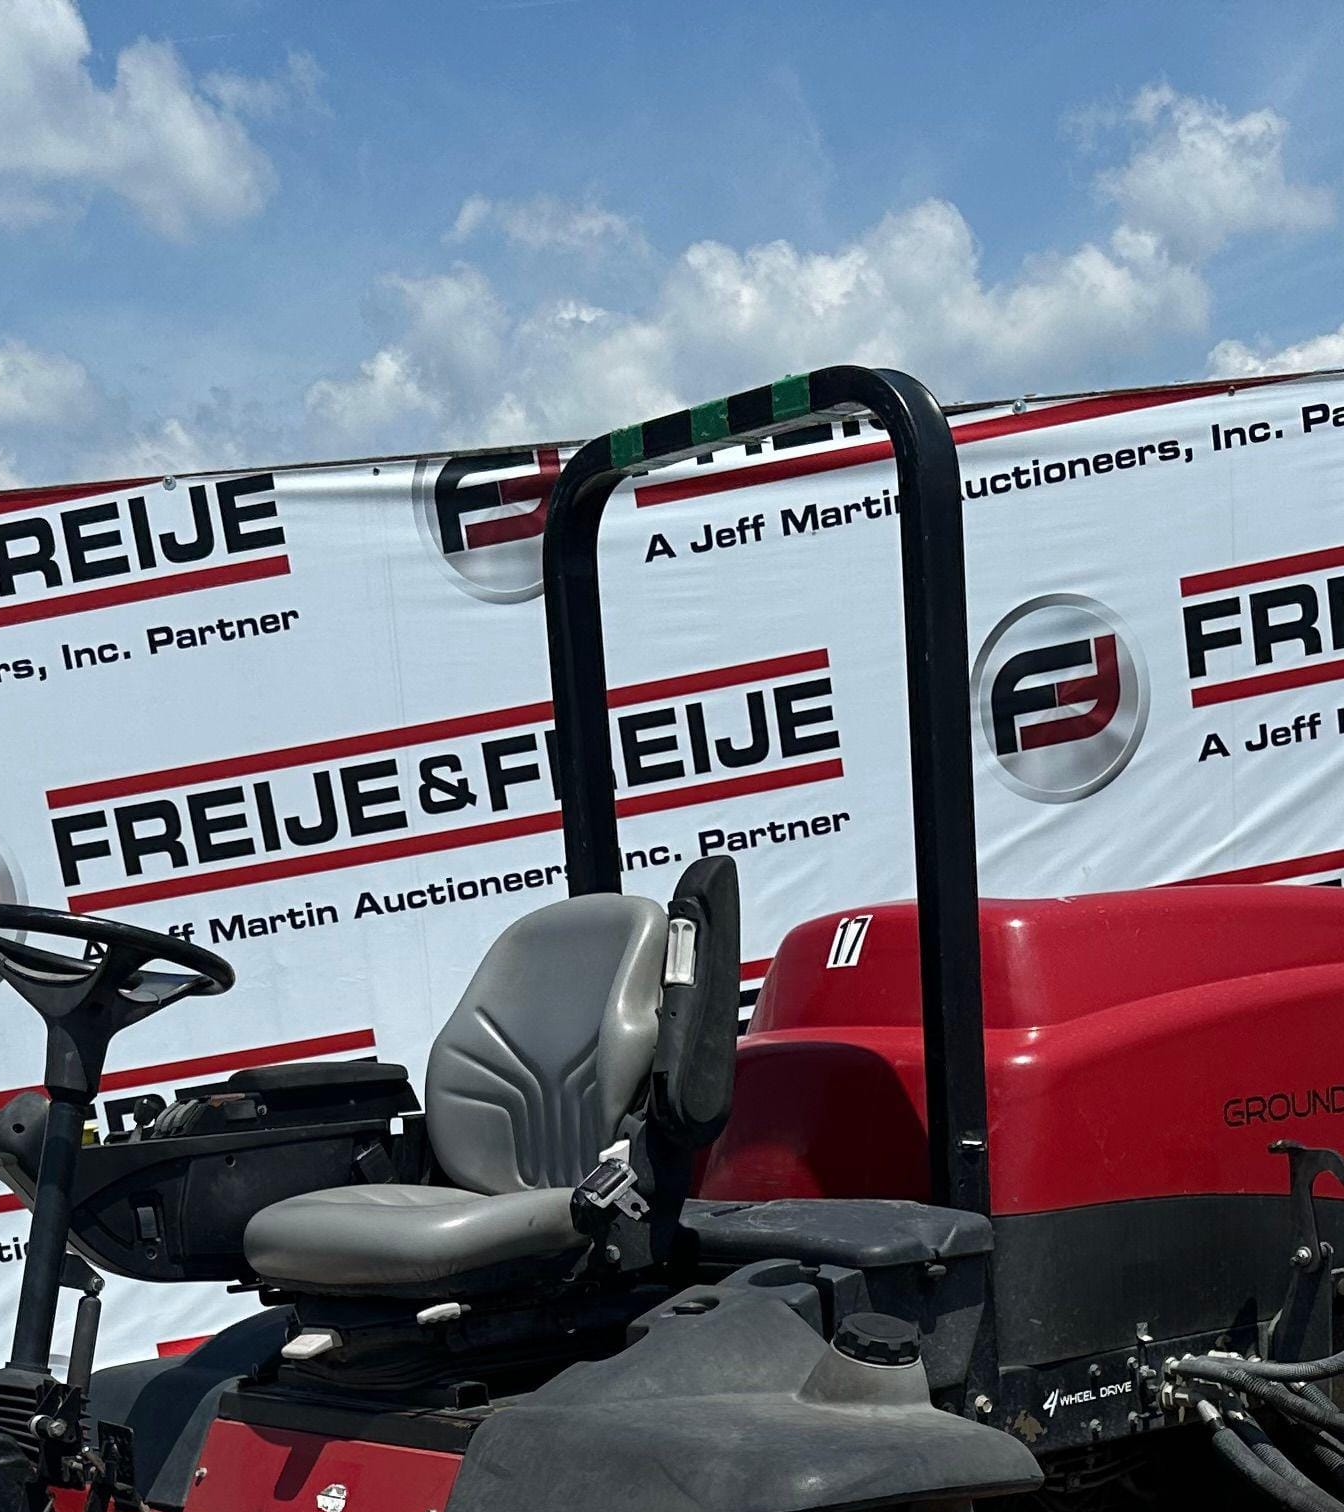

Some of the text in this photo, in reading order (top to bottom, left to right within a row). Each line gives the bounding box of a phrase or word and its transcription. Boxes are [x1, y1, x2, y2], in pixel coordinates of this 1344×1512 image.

[645, 534, 676, 562] A
[691, 514, 765, 553] Jeff
[962, 441, 1193, 501] uctioneers,
[1212, 422, 1283, 451] Inc.
[62, 644, 131, 670] Inc.
[147, 610, 299, 654] Partner
[1199, 733, 1230, 762] A
[1245, 713, 1321, 751] Jeff
[52, 678, 841, 887] FREIJE & FEIJE
[209, 903, 338, 943] Martin
[355, 864, 567, 920] Auctioneer
[699, 813, 850, 857] Partner
[833, 918, 869, 965] 17
[1042, 1381, 1132, 1418] 4 WHEEL DRIVE
